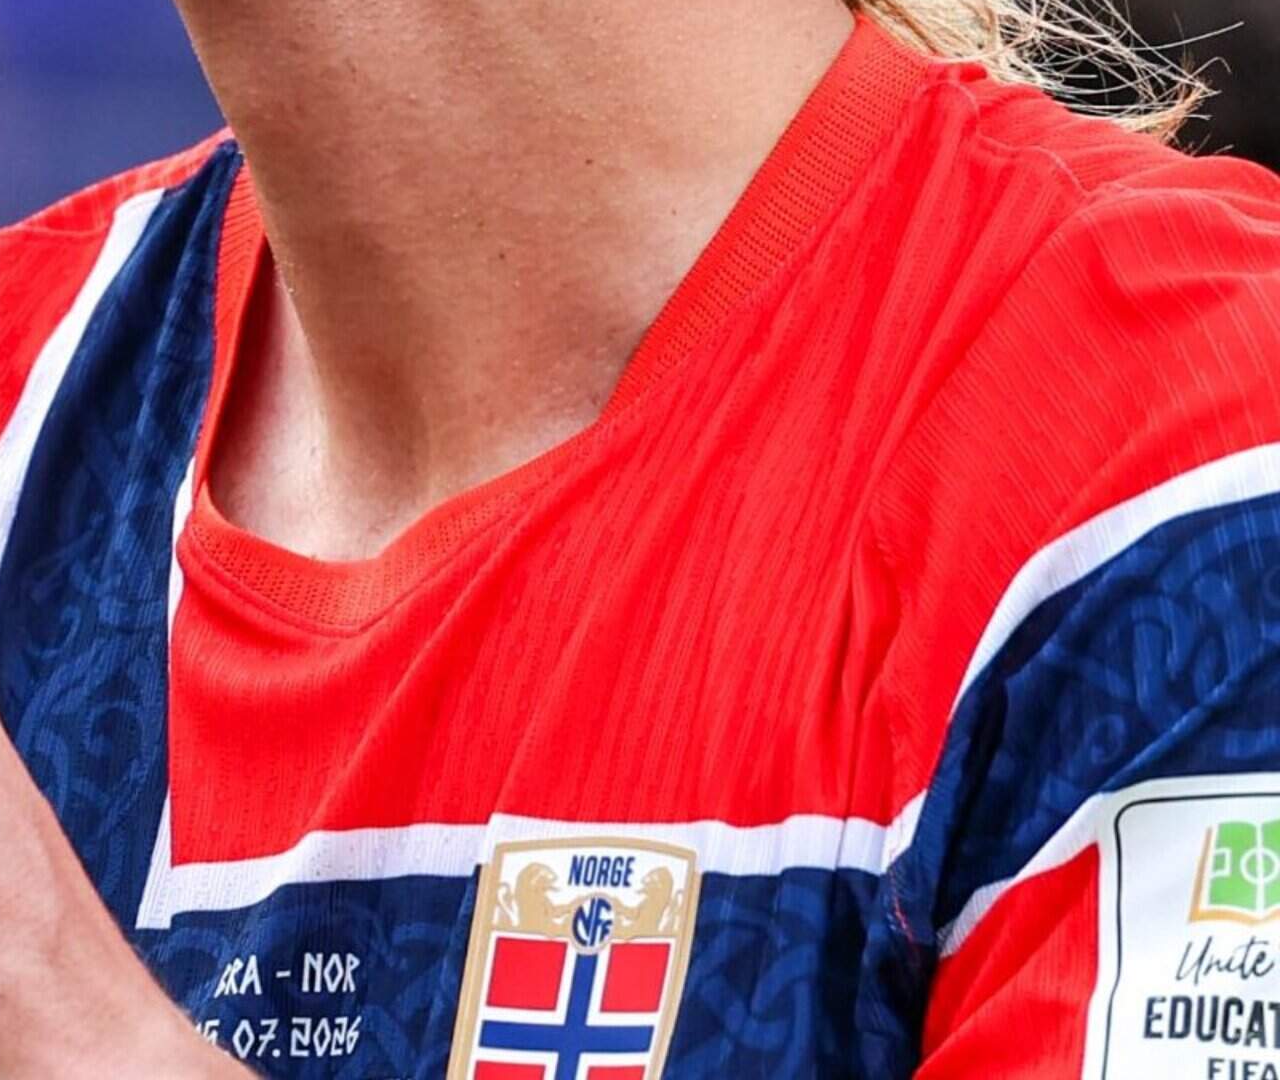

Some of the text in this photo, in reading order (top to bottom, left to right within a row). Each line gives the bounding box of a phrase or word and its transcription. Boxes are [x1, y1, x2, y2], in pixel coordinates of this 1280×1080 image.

[568, 854, 635, 887] NORGE
[302, 952, 360, 992] NOR
[1175, 935, 1275, 986] Unite
